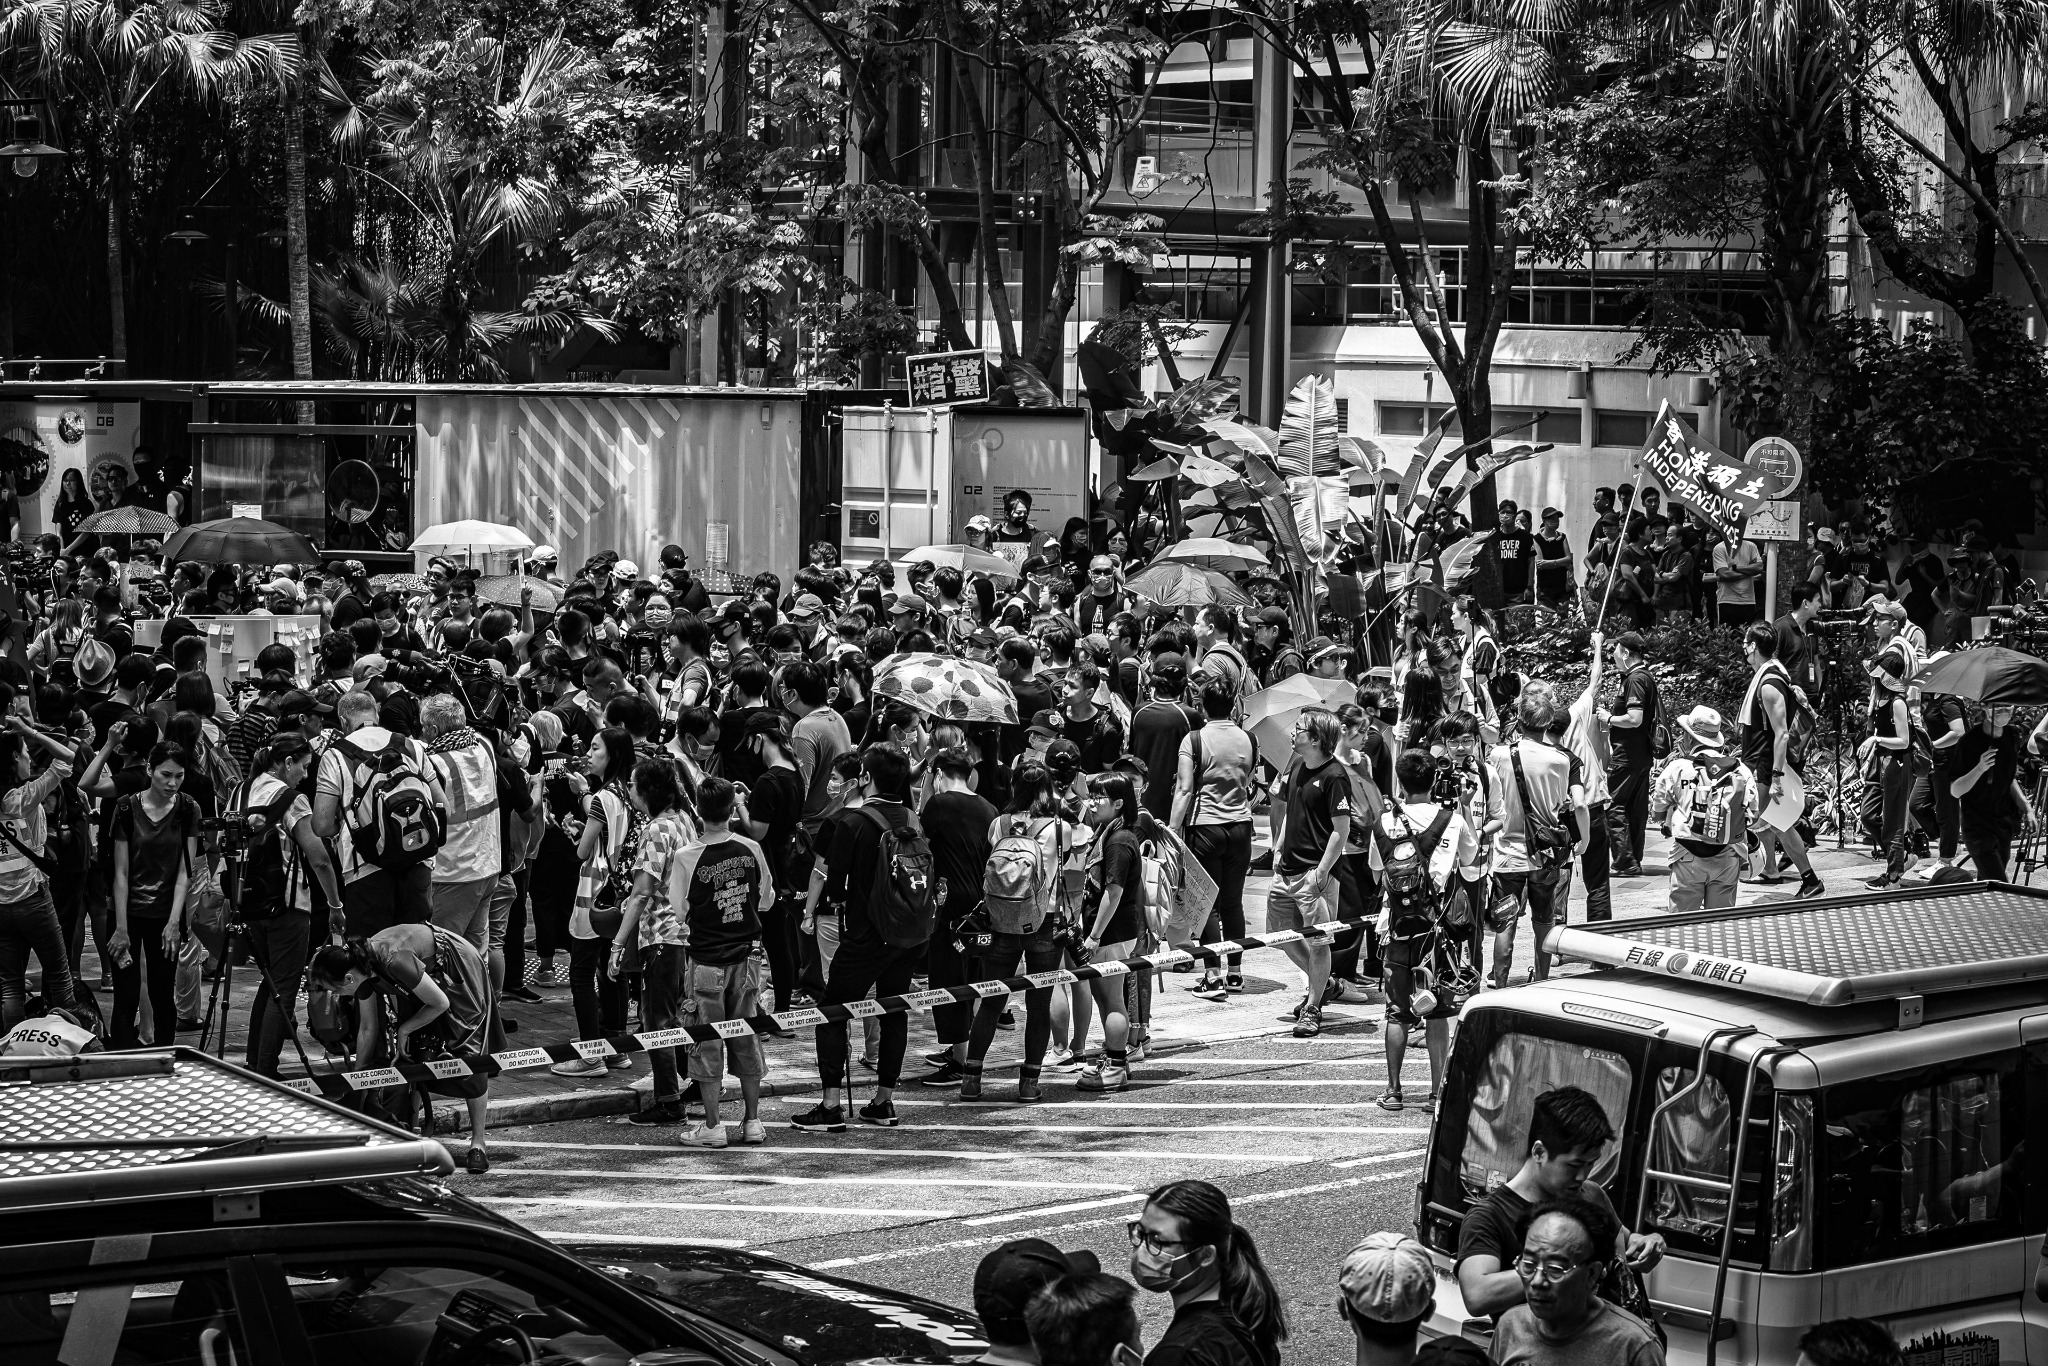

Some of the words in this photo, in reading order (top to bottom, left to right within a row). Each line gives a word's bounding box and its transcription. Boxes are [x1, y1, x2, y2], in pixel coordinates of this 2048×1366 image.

[1665, 418, 1764, 499] 香港獨立
[964, 486, 982, 494] 02
[1626, 946, 1664, 967] 有線
[1691, 959, 1747, 984] 新聞台
[9, 1029, 62, 1047] PRESS
[642, 1033, 658, 1041] POLICE
[672, 1036, 687, 1044] CROSS
[499, 1053, 518, 1061] POLICE
[529, 1057, 546, 1065] CROSS
[350, 1072, 370, 1080] POLICE
[380, 1076, 399, 1085] CROSS
